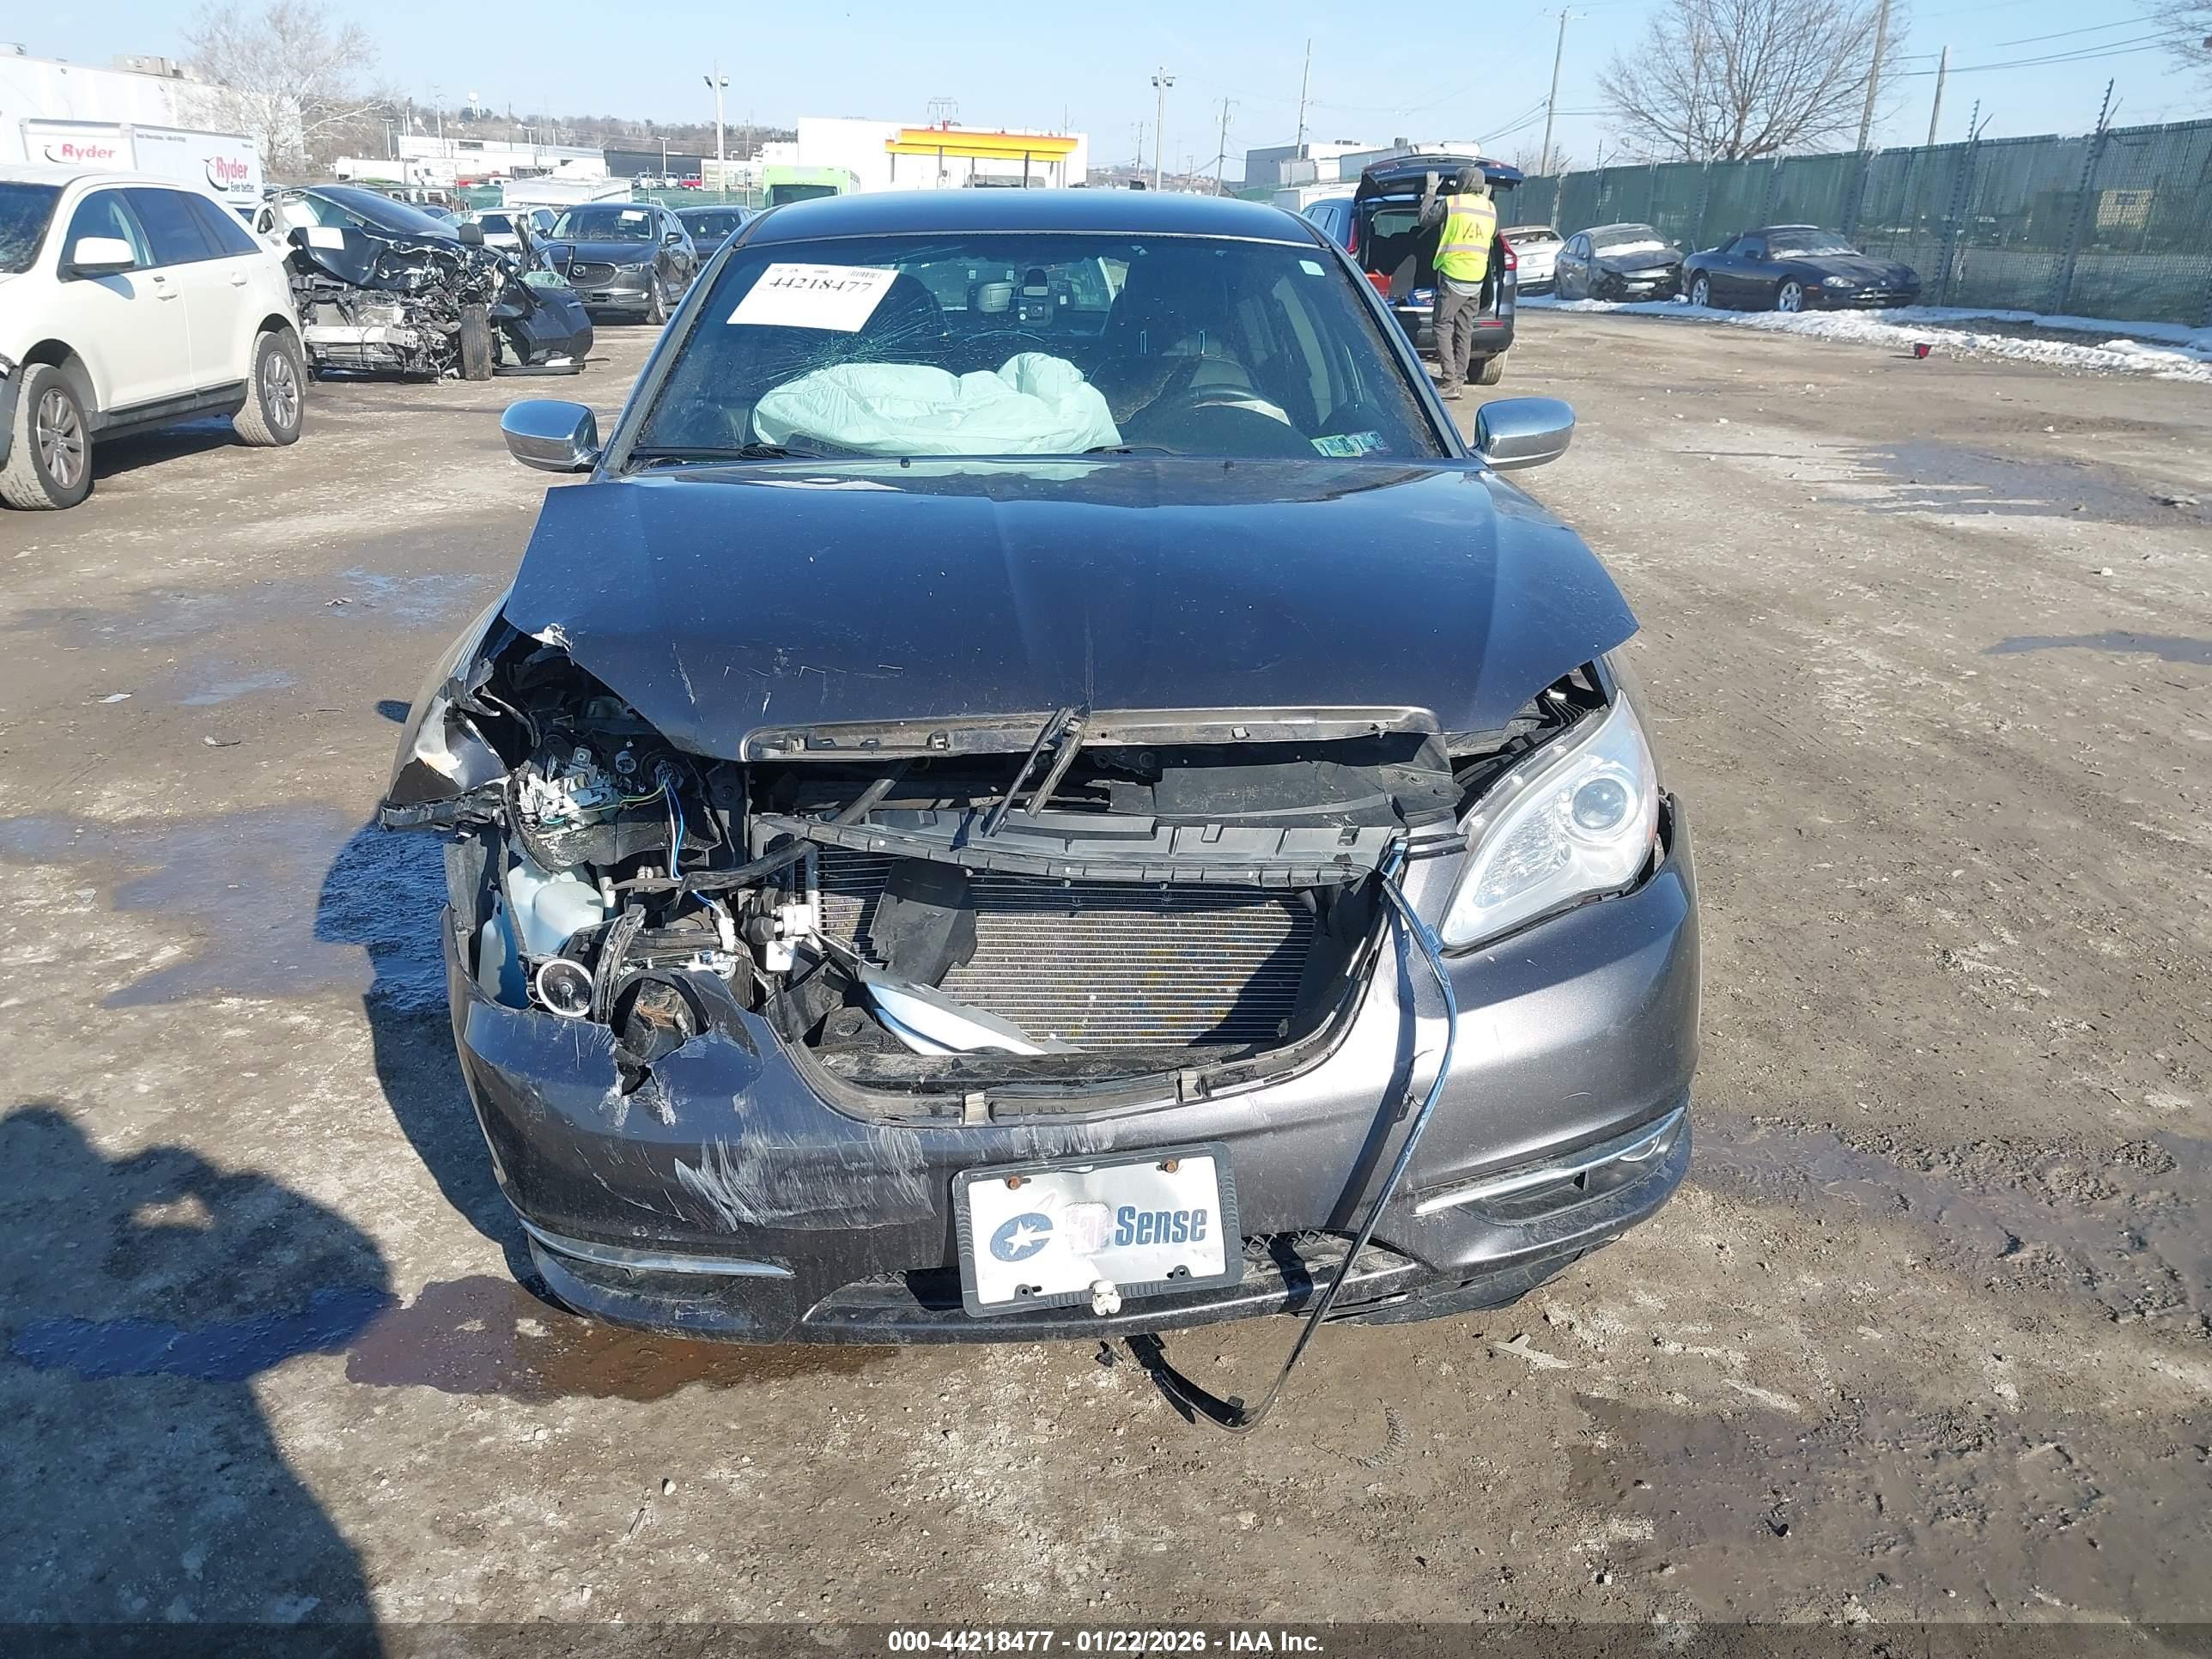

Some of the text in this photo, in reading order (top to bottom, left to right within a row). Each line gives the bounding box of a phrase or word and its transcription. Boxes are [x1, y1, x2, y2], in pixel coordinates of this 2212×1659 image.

[62, 143, 116, 161] Ryder
[216, 156, 248, 184] Ryder
[230, 181, 240, 192] Ever
[769, 276, 872, 293] 44218477
[1115, 1206, 1207, 1246] Sense
